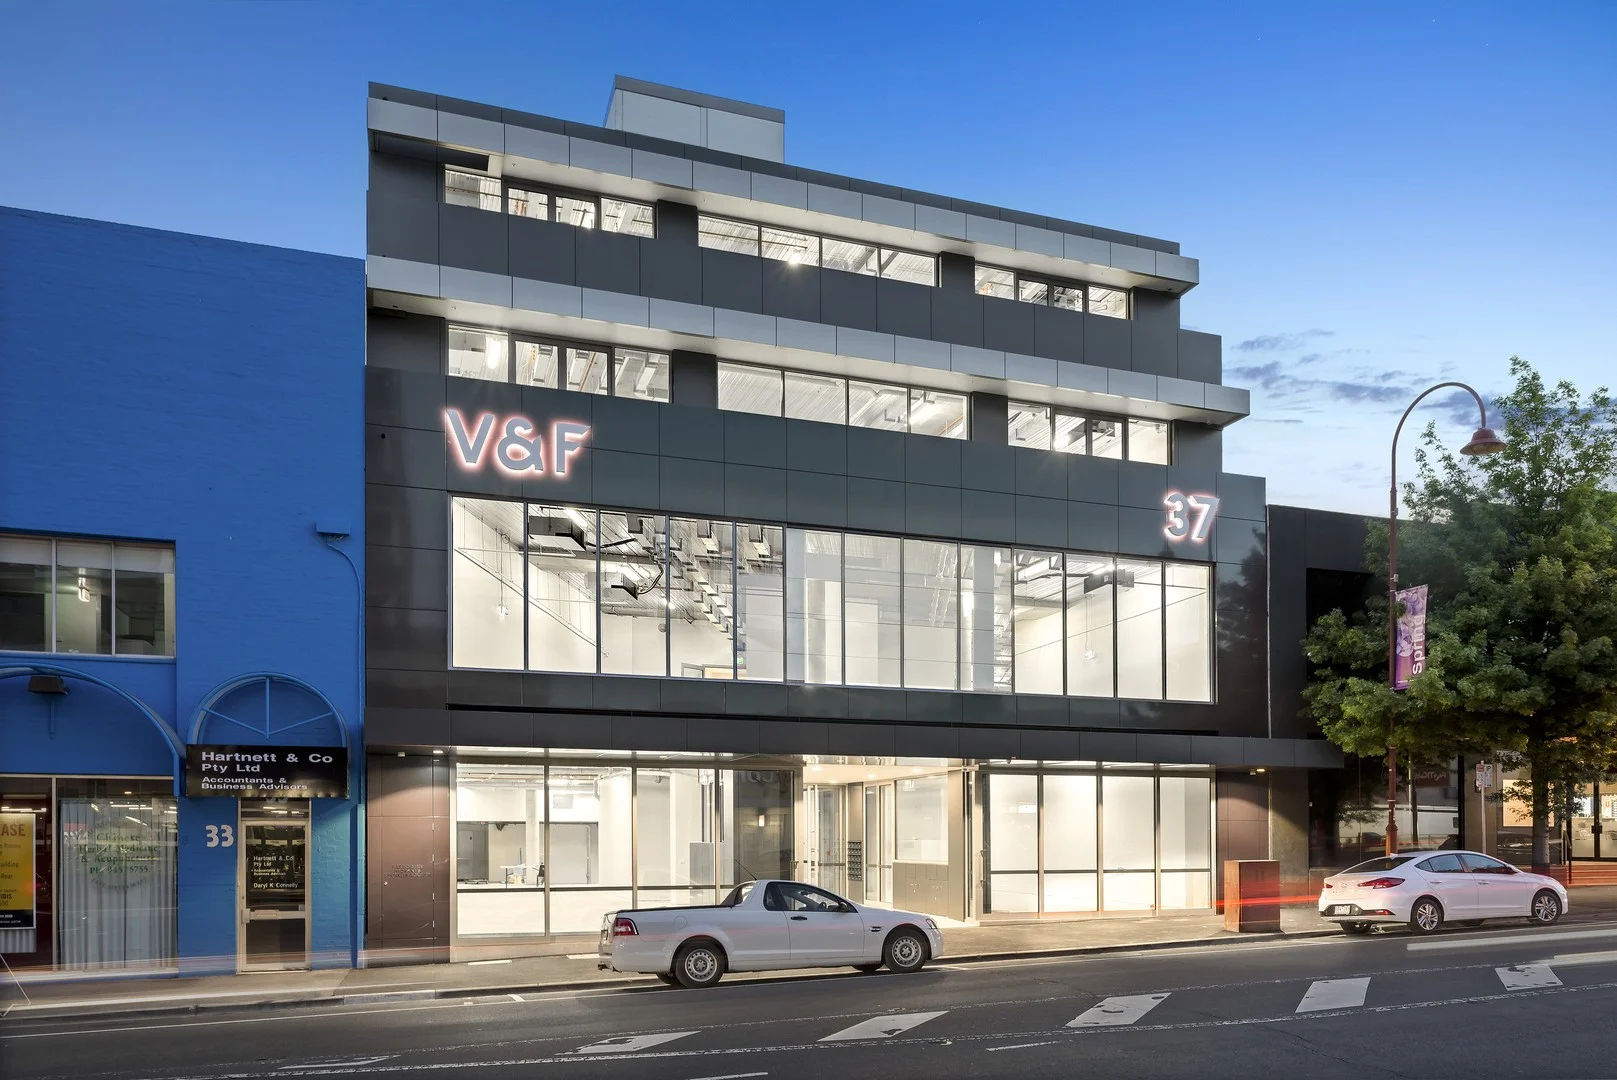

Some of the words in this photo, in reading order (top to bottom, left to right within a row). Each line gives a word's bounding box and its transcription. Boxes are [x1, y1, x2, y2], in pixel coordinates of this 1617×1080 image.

[445, 408, 592, 474] V&F
[1164, 492, 1220, 539] 37
[1412, 614, 1426, 675] spring
[201, 751, 277, 763] Hartnett
[286, 753, 299, 763] &
[308, 753, 333, 763] Co
[201, 763, 229, 774] Pty
[236, 764, 260, 772] Ltd
[201, 776, 273, 784] Accountants
[259, 783, 308, 791] Advisors
[0, 823, 26, 837] ASE
[96, 832, 141, 841] Chinese
[205, 824, 234, 848] 33
[116, 844, 158, 853] Medicine
[80, 855, 89, 863] &
[0, 861, 19, 869] uilding
[253, 882, 268, 890] Daryl
